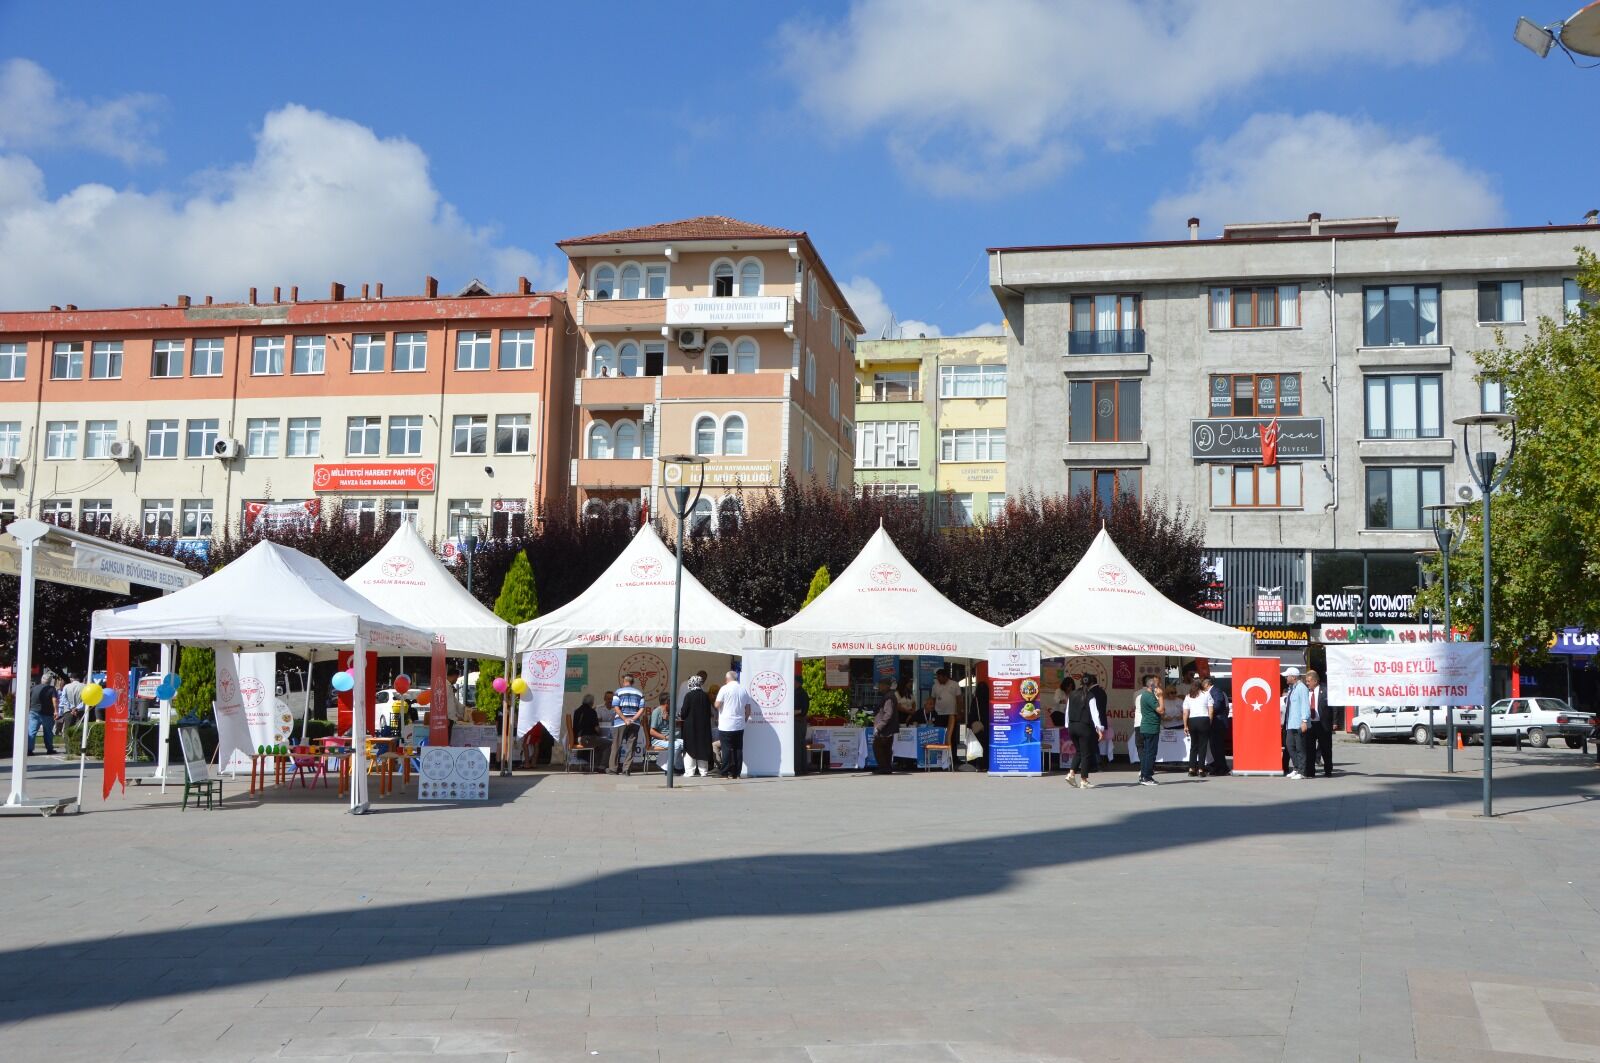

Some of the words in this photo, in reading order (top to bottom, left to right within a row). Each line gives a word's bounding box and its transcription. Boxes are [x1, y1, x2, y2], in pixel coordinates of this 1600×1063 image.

[1218, 424, 1261, 446] Dilek
[331, 468, 364, 476] MİLLİYETÇİ
[364, 468, 392, 476] HAREKET
[393, 468, 416, 476] PARTİSİ
[100, 559, 125, 575] SAMSUN
[577, 634, 612, 642] SAMSUN
[622, 634, 653, 643] SAĞLIK
[656, 634, 706, 644] MÜDRLÜĞÜ
[1256, 630, 1308, 640] DONDURMA
[832, 642, 865, 650] SAMSUN
[867, 641, 874, 650] İL
[876, 641, 905, 650] SAĞLIK
[908, 642, 958, 652] MÜDÜRLÜĞÜ
[1117, 643, 1145, 651] SAĞLIK
[1147, 643, 1196, 652] MÜDÜRLÜĞÜ
[1374, 662, 1404, 673] 03-09
[1406, 658, 1438, 672] EYLÜL
[1348, 686, 1375, 696] HALK
[1378, 684, 1419, 696] SAĞLIĞI
[1422, 685, 1468, 696] HAFTASI
